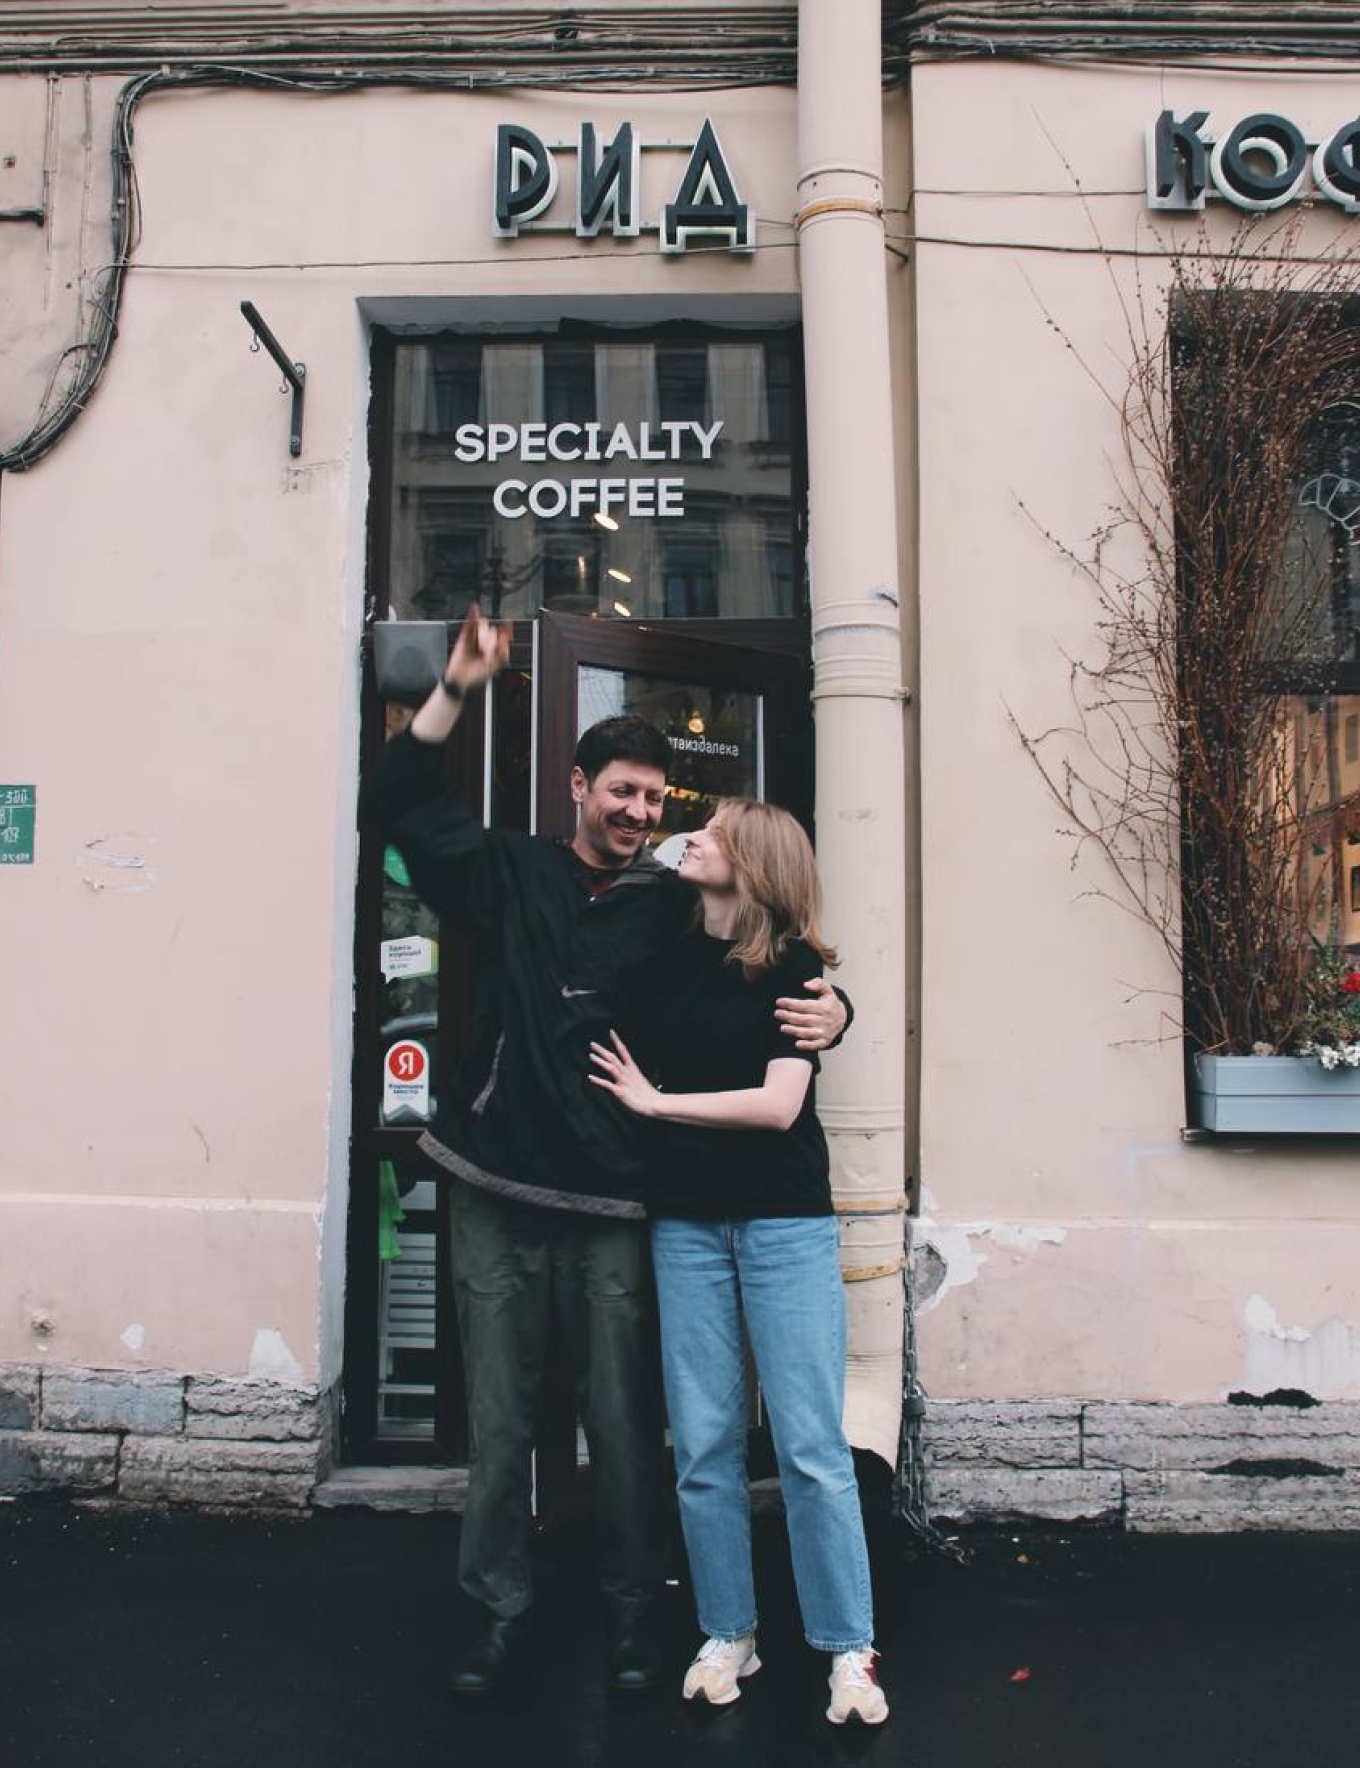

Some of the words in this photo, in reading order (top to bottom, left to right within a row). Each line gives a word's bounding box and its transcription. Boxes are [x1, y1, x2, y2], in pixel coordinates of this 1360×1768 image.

[493, 117, 756, 254] РИД
[454, 421, 724, 463] SPECIALTY
[493, 478, 685, 518] COFFEE
[398, 1051, 414, 1075] Я
